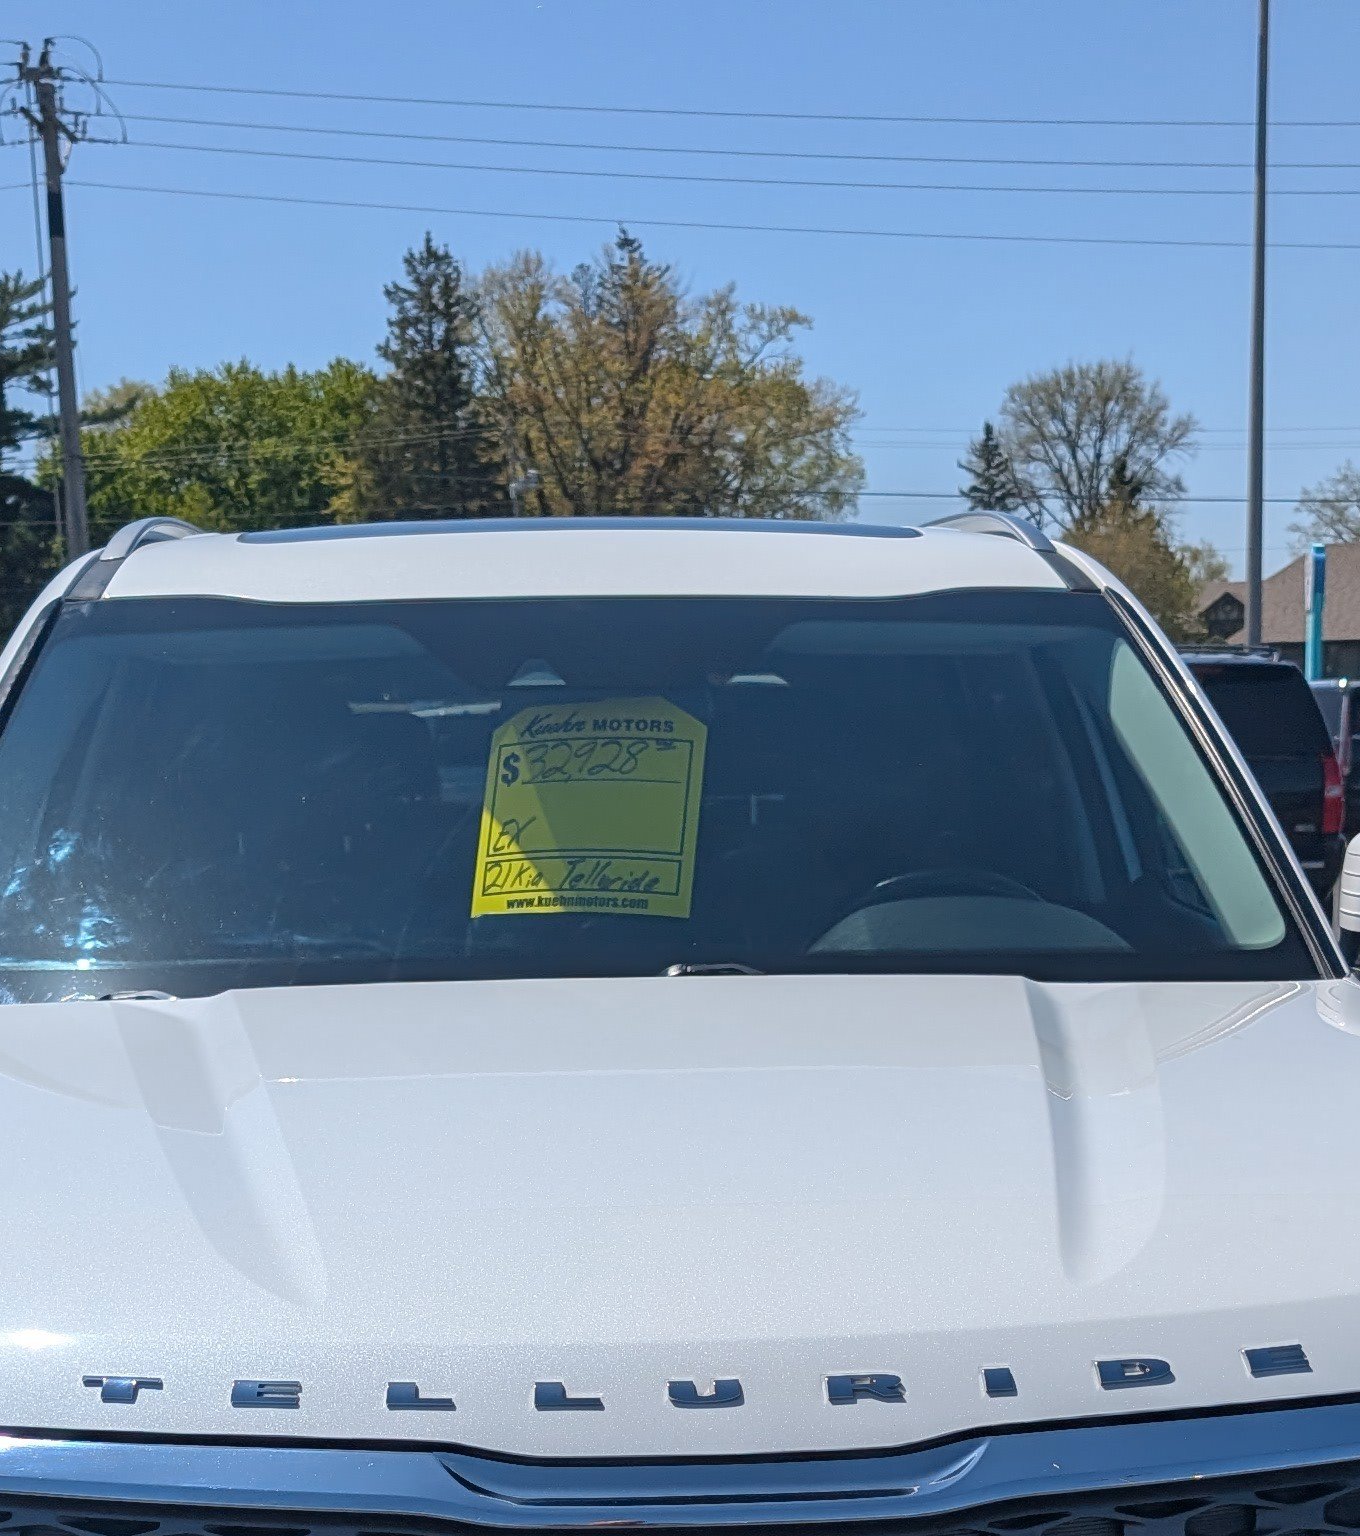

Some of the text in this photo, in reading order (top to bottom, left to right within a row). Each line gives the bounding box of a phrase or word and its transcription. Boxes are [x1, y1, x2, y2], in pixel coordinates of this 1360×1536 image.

[593, 718, 674, 733] MOTORS
[493, 816, 537, 852] EX
[559, 860, 661, 892] Telluride
[506, 895, 649, 910] www.kuehnmotors.com
[83, 1343, 1313, 1411] TELLURIDE
